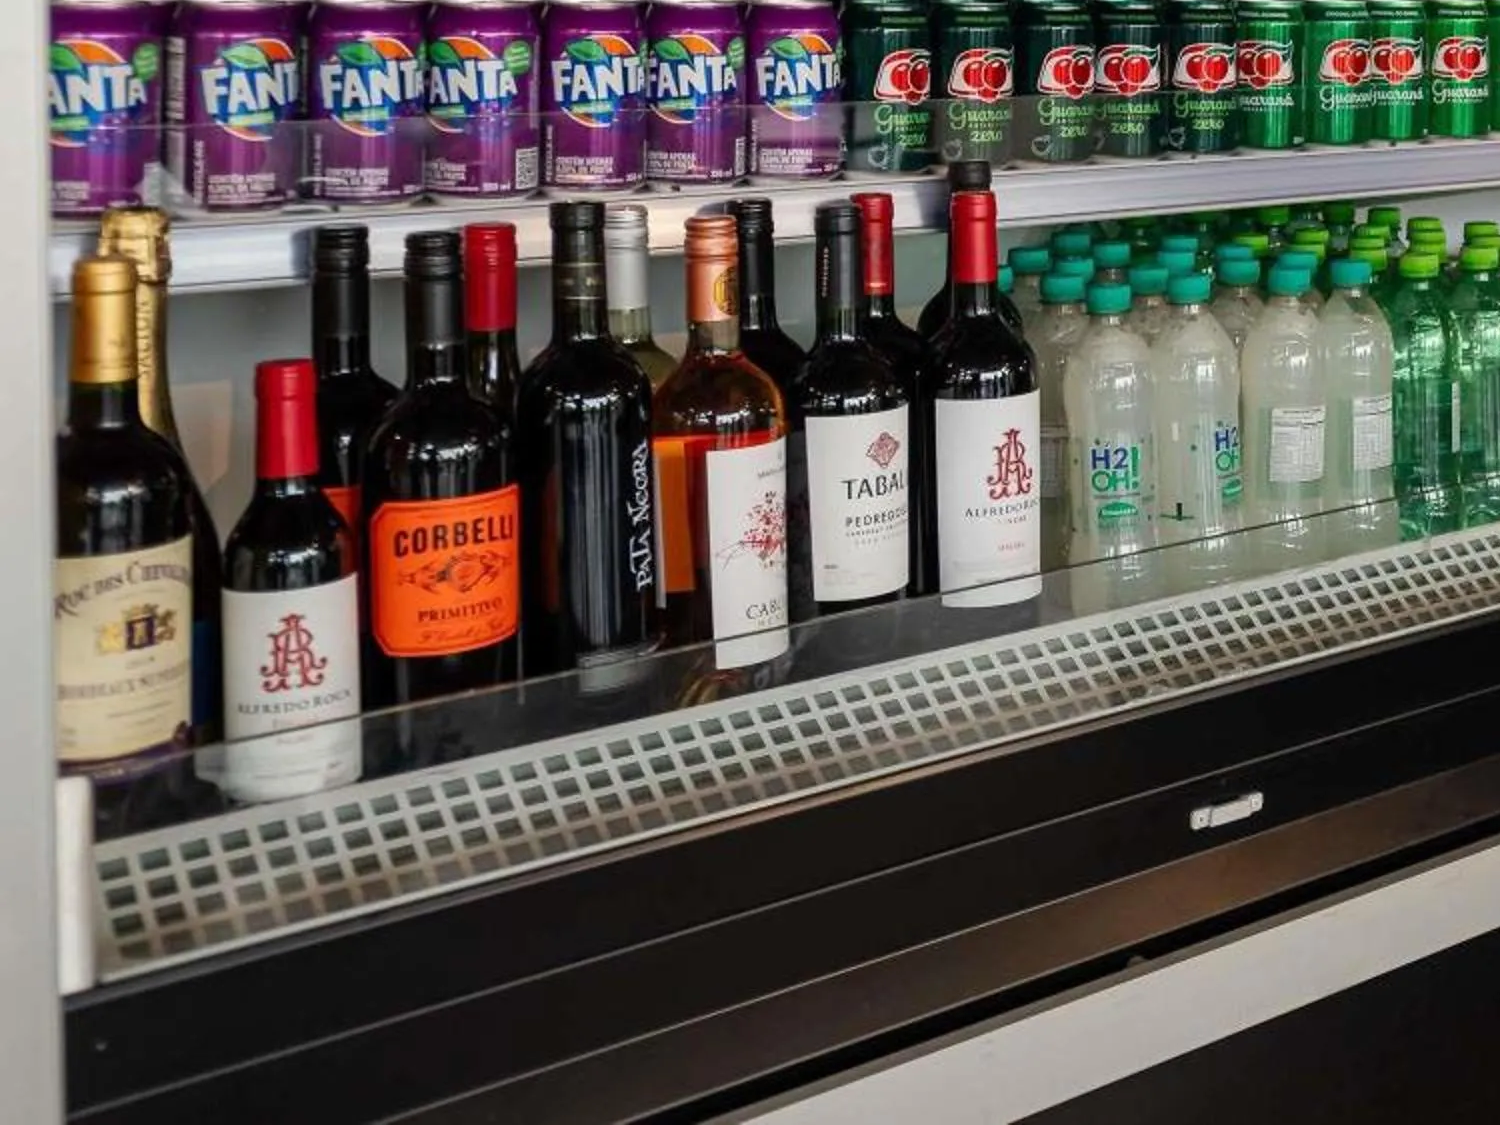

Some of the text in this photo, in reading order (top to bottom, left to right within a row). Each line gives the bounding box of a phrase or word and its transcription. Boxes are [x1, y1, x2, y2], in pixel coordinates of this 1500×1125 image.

[47, 64, 148, 115] ANTA
[201, 60, 298, 115] FANT
[428, 59, 518, 104] ANTA
[755, 54, 841, 97] FANTA
[1239, 92, 1294, 106] uaraná
[841, 469, 905, 500] TABAL
[418, 597, 504, 623] PRIMITIVO
